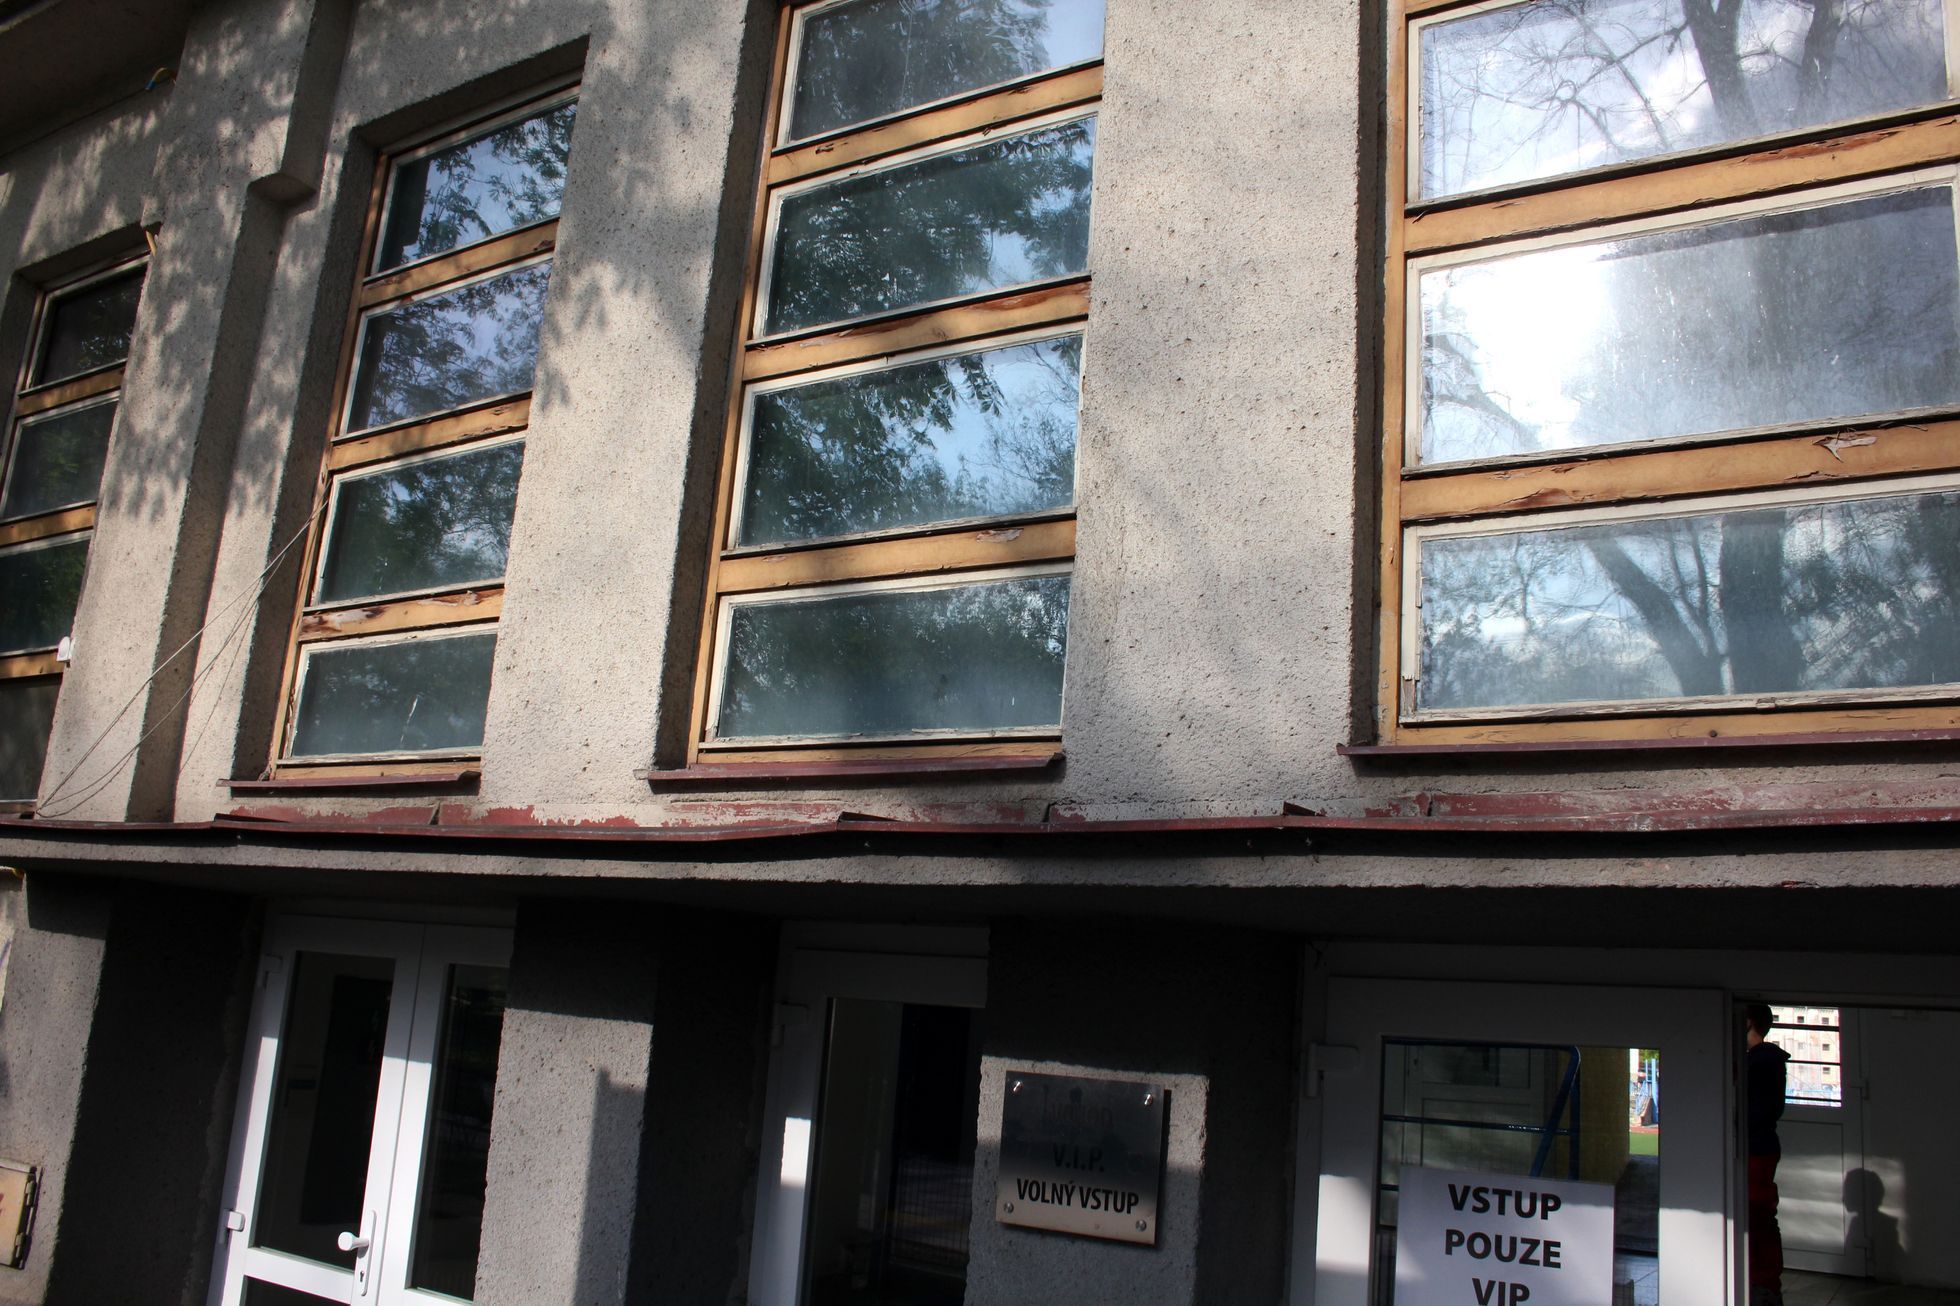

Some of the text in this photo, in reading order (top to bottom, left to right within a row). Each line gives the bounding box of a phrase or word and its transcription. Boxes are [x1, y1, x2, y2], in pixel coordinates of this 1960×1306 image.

[1053, 1142, 1105, 1173] V.I.P.
[1016, 1177, 1139, 1214] VOLNÝ VSTUP
[1447, 1183, 1562, 1220] VSTUP
[1444, 1228, 1561, 1269] POUZE
[1471, 1277, 1530, 1306] VIP
